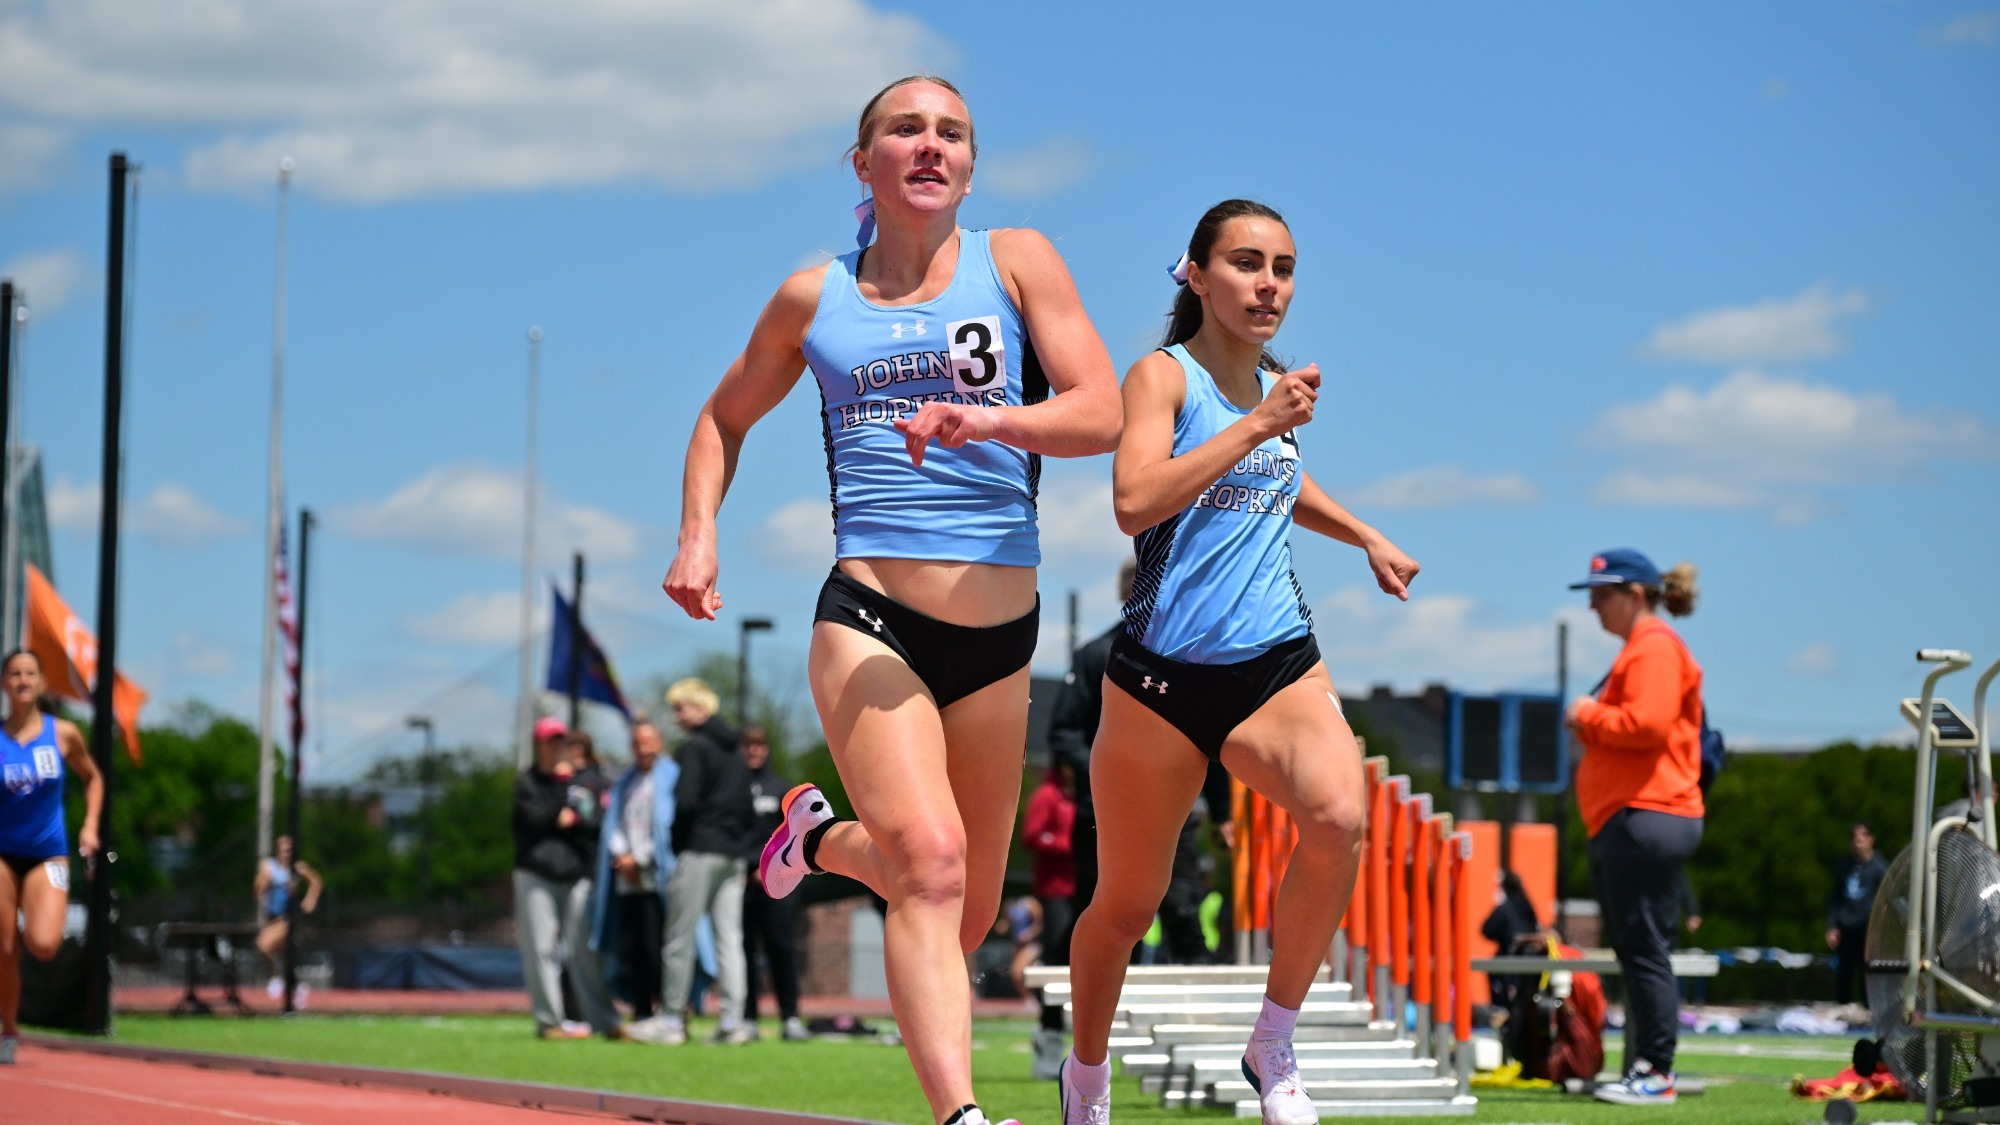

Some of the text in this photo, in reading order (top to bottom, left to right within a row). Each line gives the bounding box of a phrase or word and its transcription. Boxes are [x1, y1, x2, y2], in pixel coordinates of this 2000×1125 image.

[851, 349, 953, 396] JOHN
[955, 322, 997, 387] 3
[1222, 448, 1295, 486] OHNS
[1193, 484, 1297, 517] HOPKN
